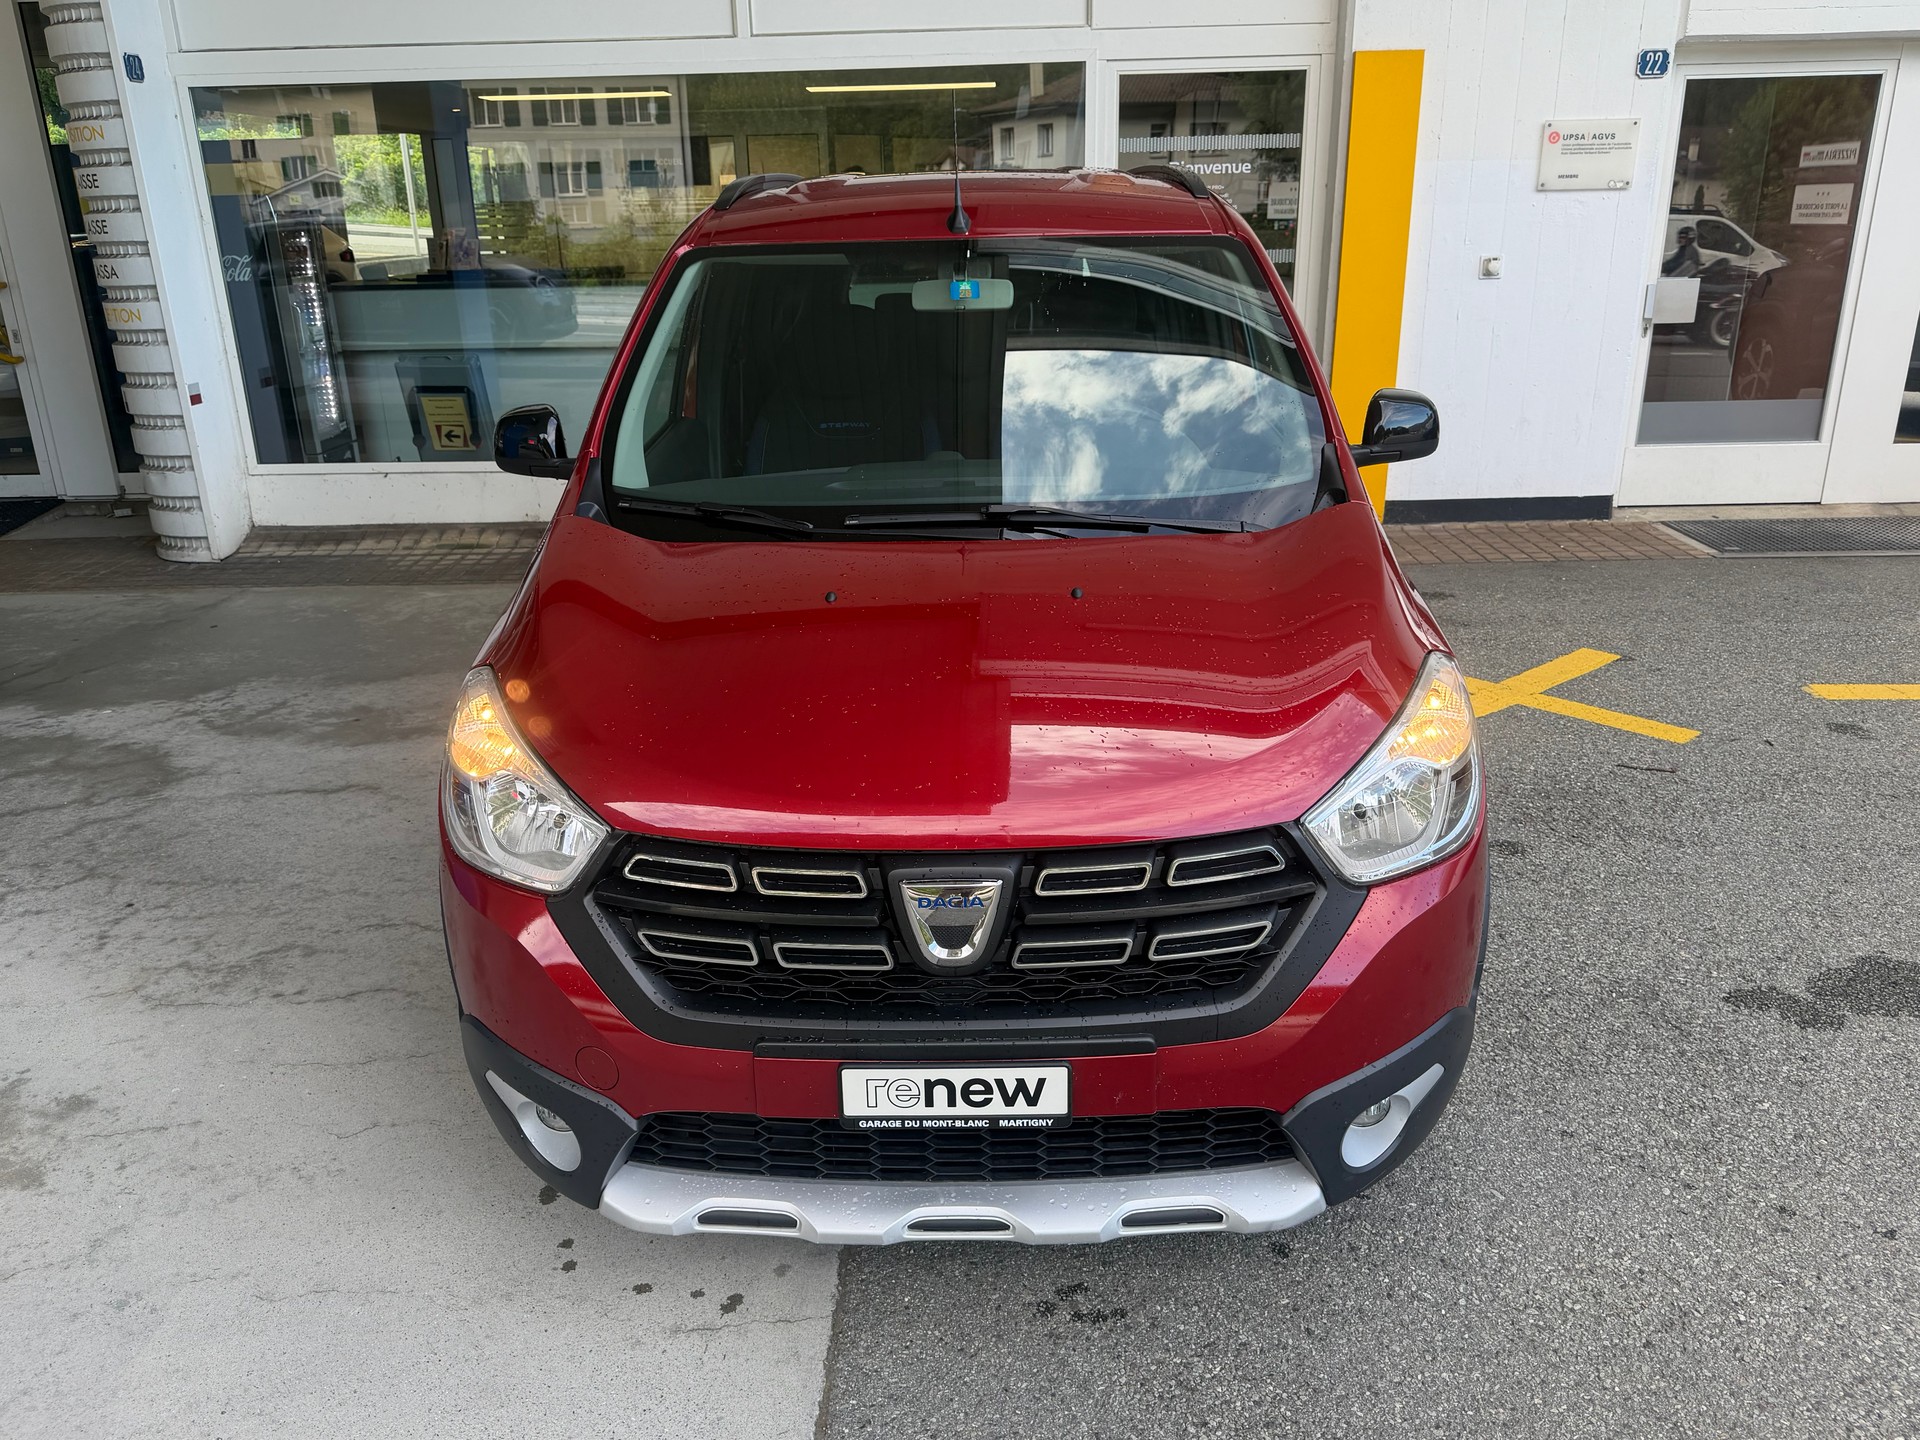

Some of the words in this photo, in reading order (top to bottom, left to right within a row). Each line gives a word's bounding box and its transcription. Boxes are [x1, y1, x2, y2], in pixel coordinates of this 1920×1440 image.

[130, 56, 142, 79] 24
[1645, 52, 1663, 74] 22
[1562, 133, 1586, 141] UPSA
[1591, 133, 1616, 141] AGVS
[917, 895, 985, 909] DACIA
[866, 1078, 1047, 1109] renew
[859, 1120, 902, 1128] GARAGE
[905, 1120, 920, 1128] DU
[922, 1119, 990, 1127] MONT-BLANC
[999, 1119, 1054, 1127] MARTIGNY
